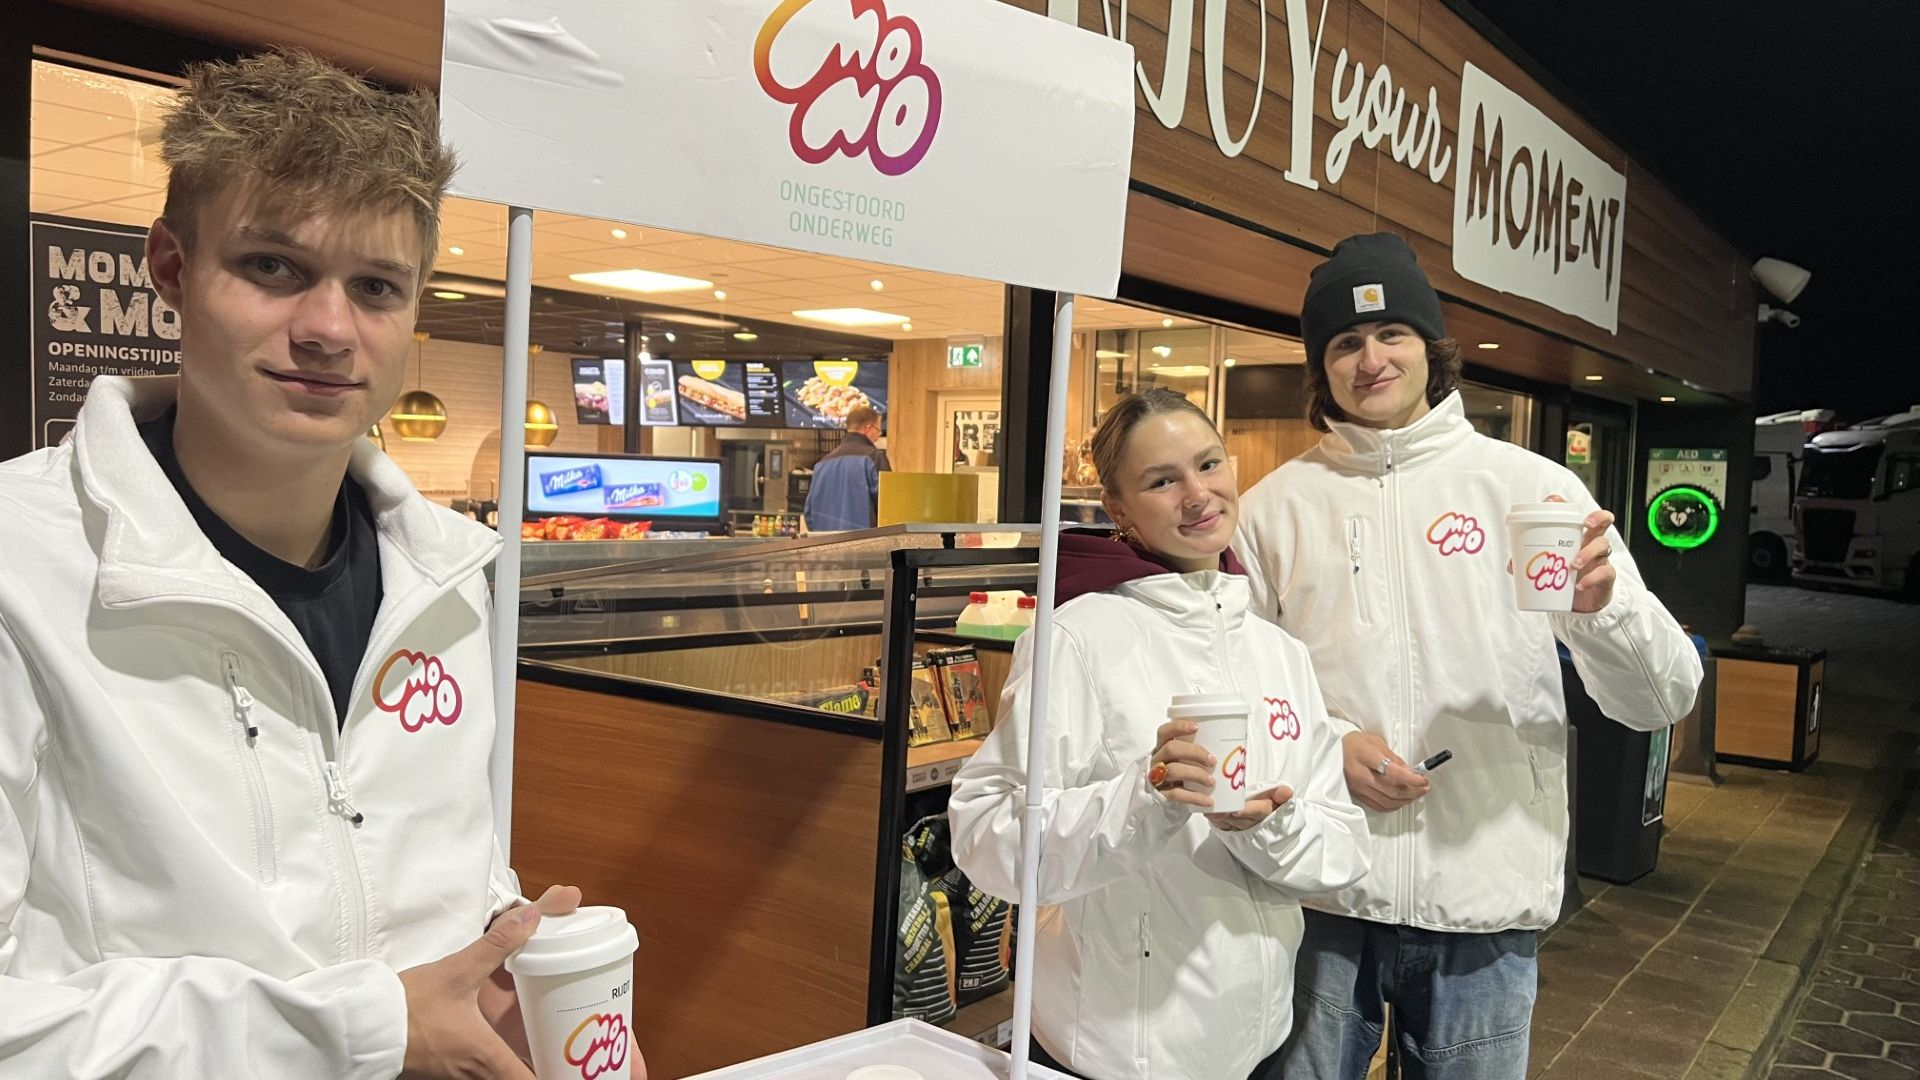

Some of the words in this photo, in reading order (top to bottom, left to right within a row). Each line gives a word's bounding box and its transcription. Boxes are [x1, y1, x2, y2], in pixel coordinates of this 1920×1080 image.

[1326, 48, 1451, 184] your
[1466, 102, 1619, 302] MOMENT
[780, 179, 905, 222] ONGESTOORD
[789, 210, 893, 247] ONDERWEG
[48, 284, 92, 334] &
[48, 362, 98, 375] Maandag
[100, 365, 118, 375] t/m
[1677, 449, 1699, 459] AED
[550, 469, 584, 491] Milka
[611, 484, 645, 503] Milka
